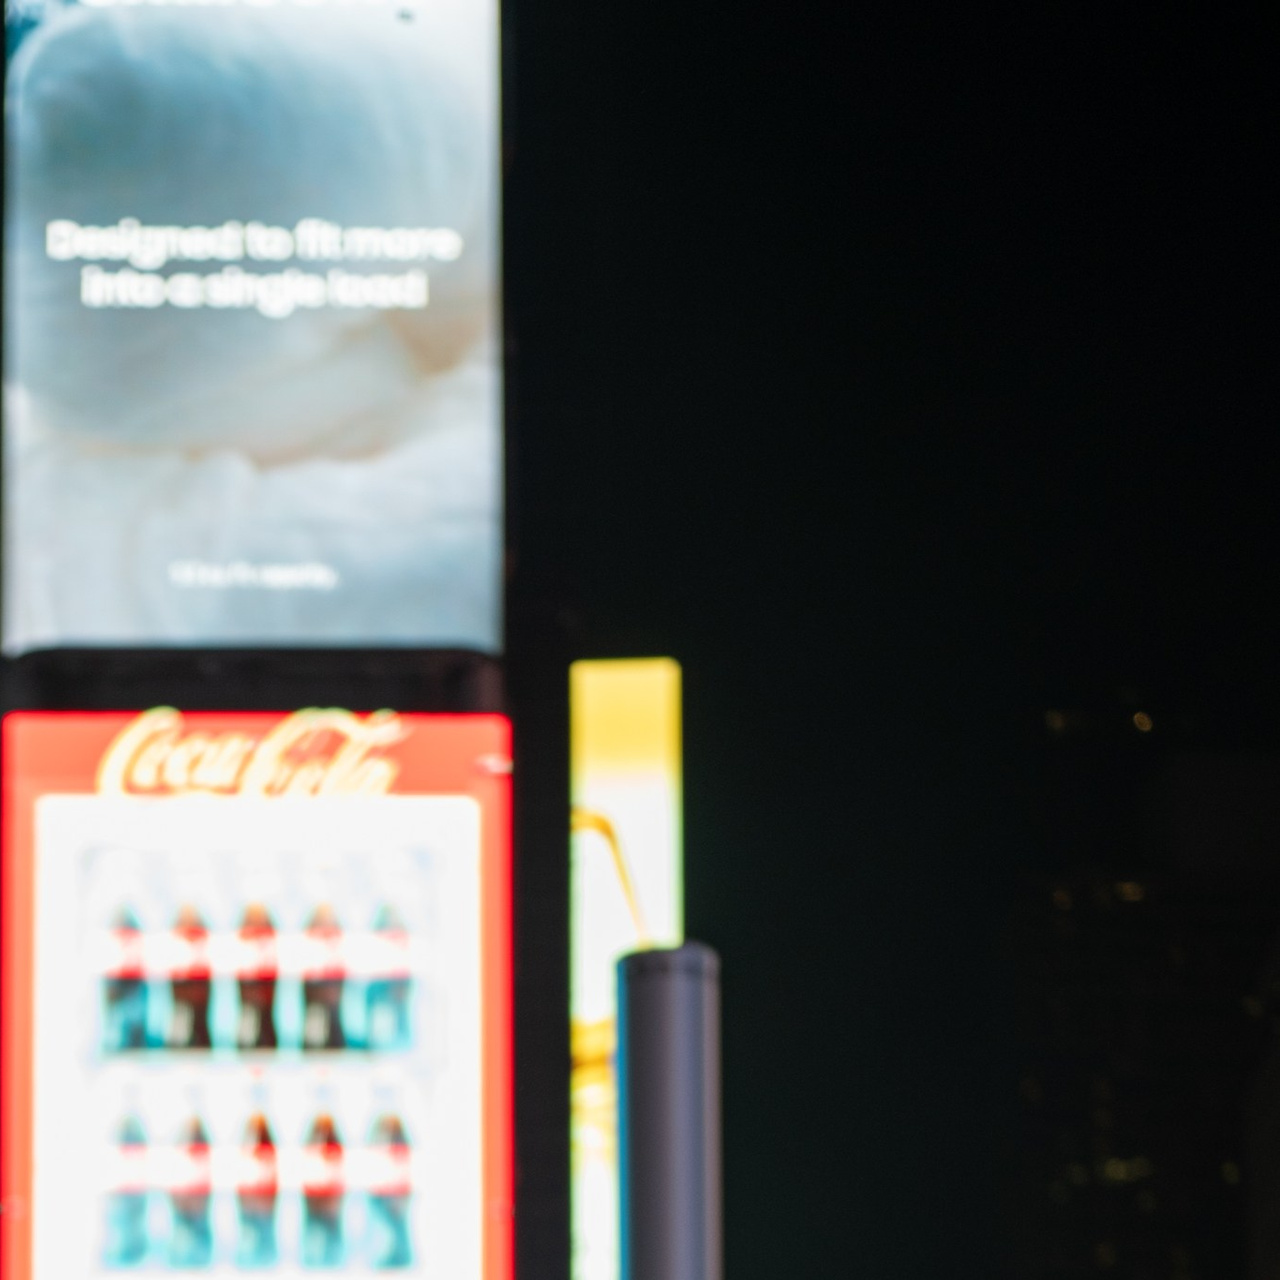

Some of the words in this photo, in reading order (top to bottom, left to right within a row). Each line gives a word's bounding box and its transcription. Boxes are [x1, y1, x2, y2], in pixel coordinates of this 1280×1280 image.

[46, 216, 243, 270] Designed
[246, 220, 294, 262] to
[295, 217, 342, 261] fit
[343, 227, 464, 262] more
[80, 264, 166, 309] into
[167, 272, 203, 309] a
[204, 264, 326, 319] single
